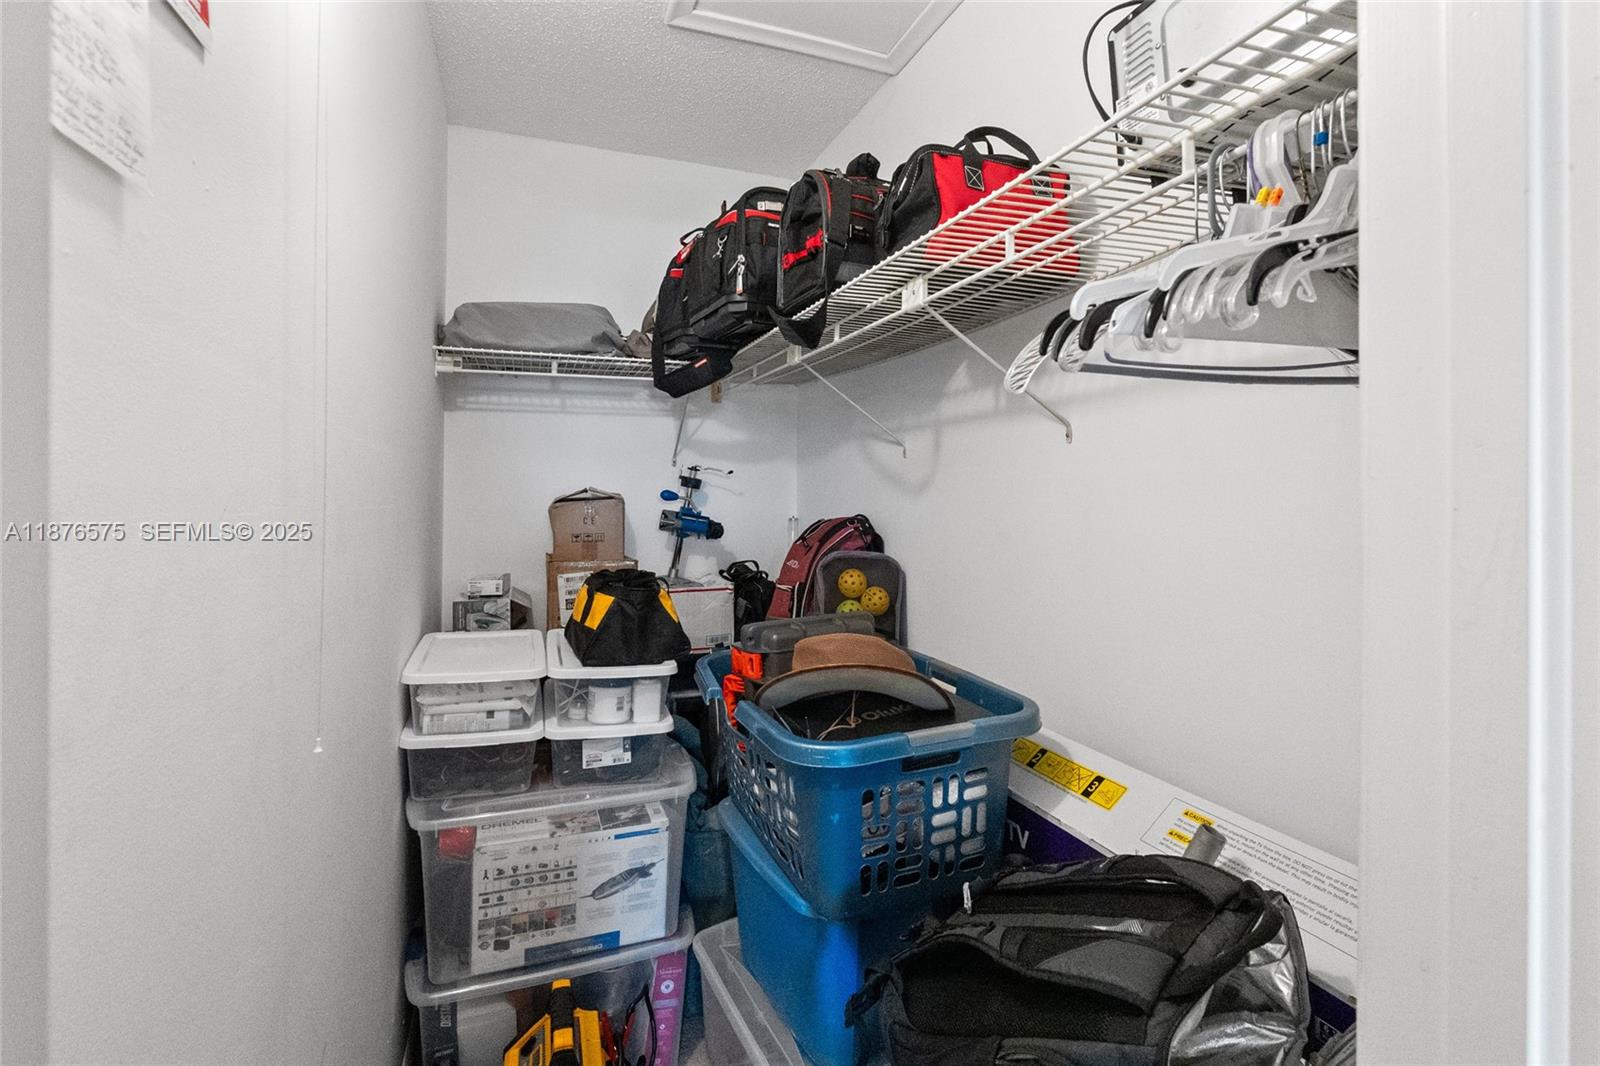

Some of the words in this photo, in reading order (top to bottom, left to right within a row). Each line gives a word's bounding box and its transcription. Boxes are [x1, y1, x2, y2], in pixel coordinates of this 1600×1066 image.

[1031, 752, 1043, 764] 2
[1087, 781, 1099, 793] 3
[1188, 812, 1212, 826] CAUTION
[1006, 820, 1030, 850] TV
[1301, 862, 1313, 871] NOT
[1311, 868, 1327, 879] press
[1332, 917, 1354, 932] resultar
